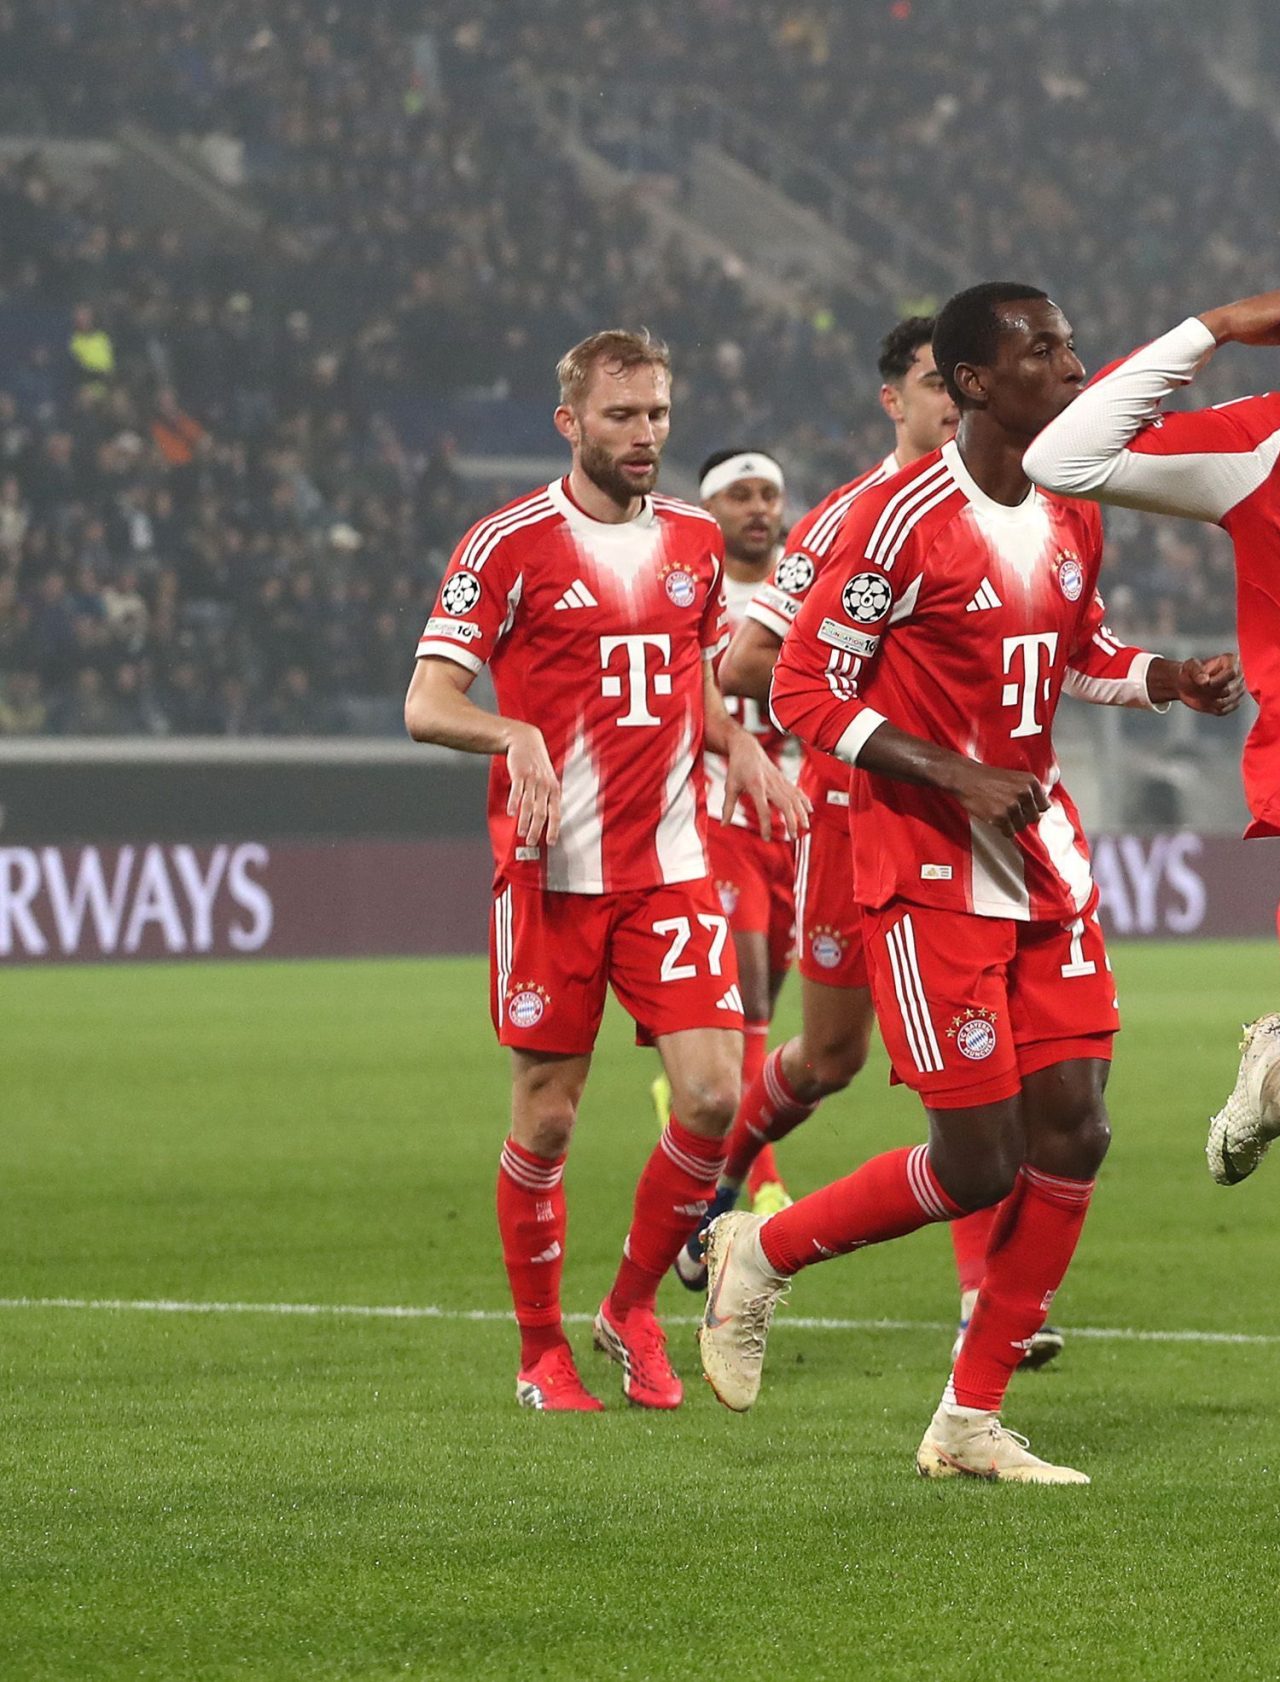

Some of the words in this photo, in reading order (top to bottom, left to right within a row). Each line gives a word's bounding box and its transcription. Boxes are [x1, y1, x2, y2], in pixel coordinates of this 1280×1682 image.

[600, 634, 672, 727] T
[1002, 632, 1059, 738] T
[0, 842, 273, 955] RWAYS
[653, 913, 729, 982] 27
[964, 1022, 991, 1033] BAYERN
